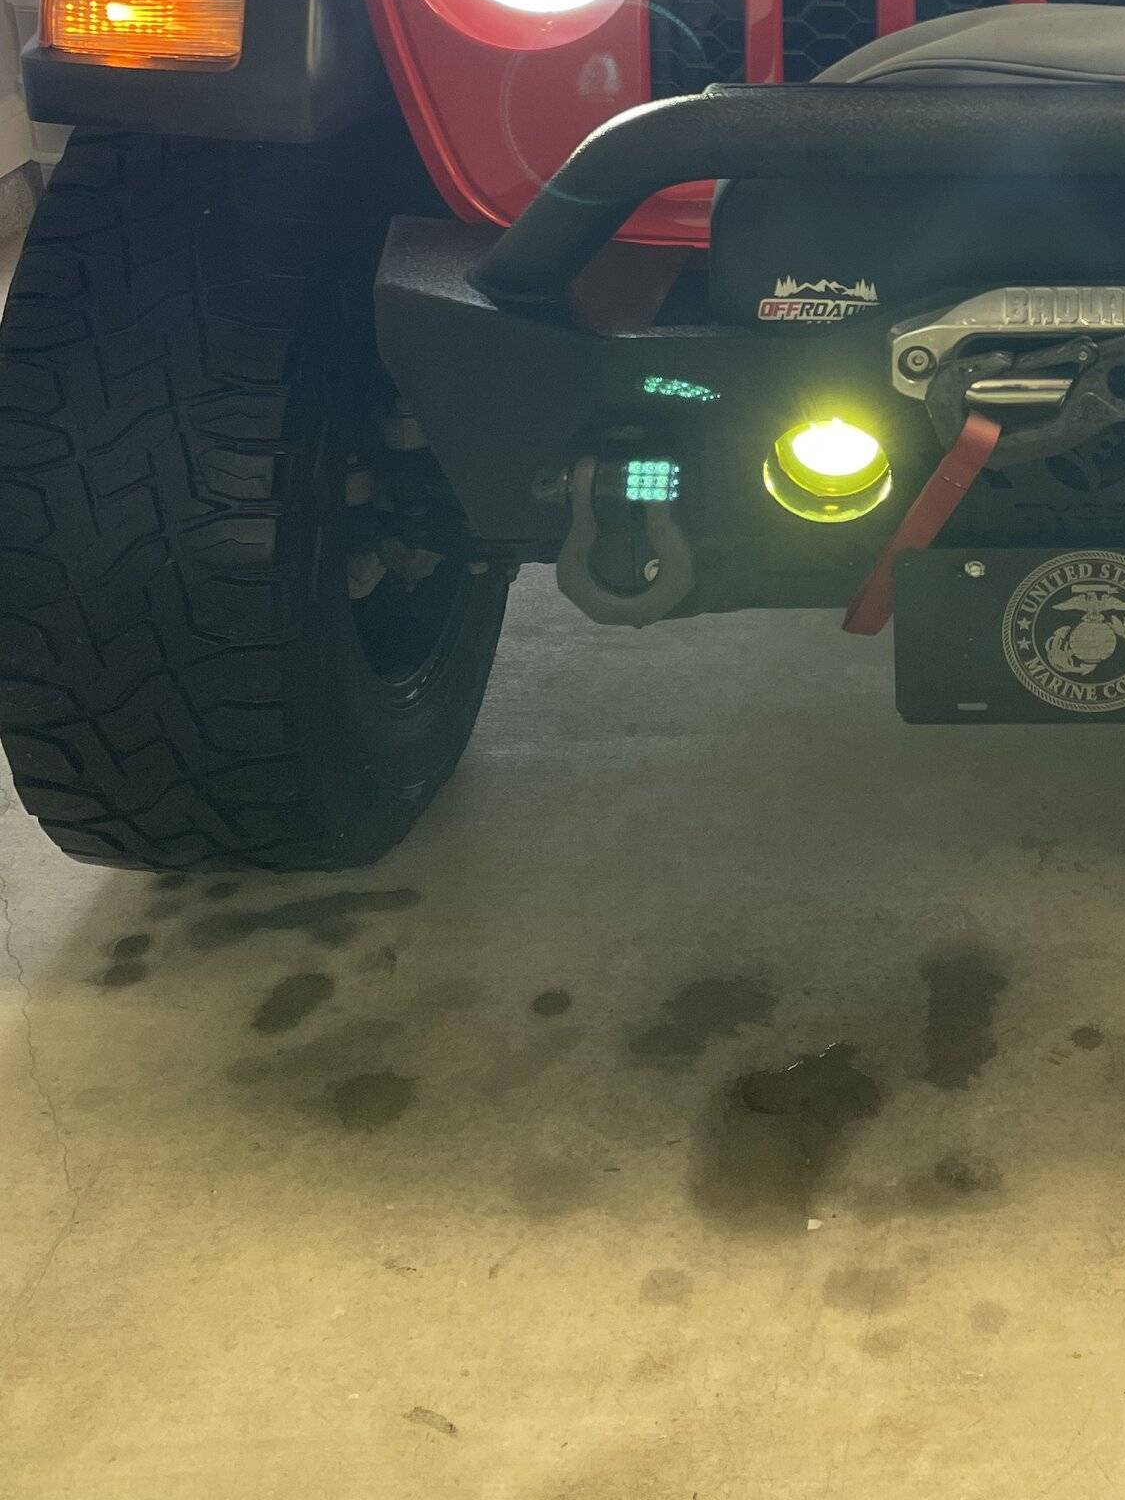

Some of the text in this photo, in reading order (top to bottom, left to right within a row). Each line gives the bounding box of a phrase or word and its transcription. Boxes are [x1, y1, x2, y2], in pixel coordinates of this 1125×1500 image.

[760, 301, 858, 318] OFFROAD
[1020, 563, 1094, 613] UNITED
[1023, 657, 1098, 702] MARINE
